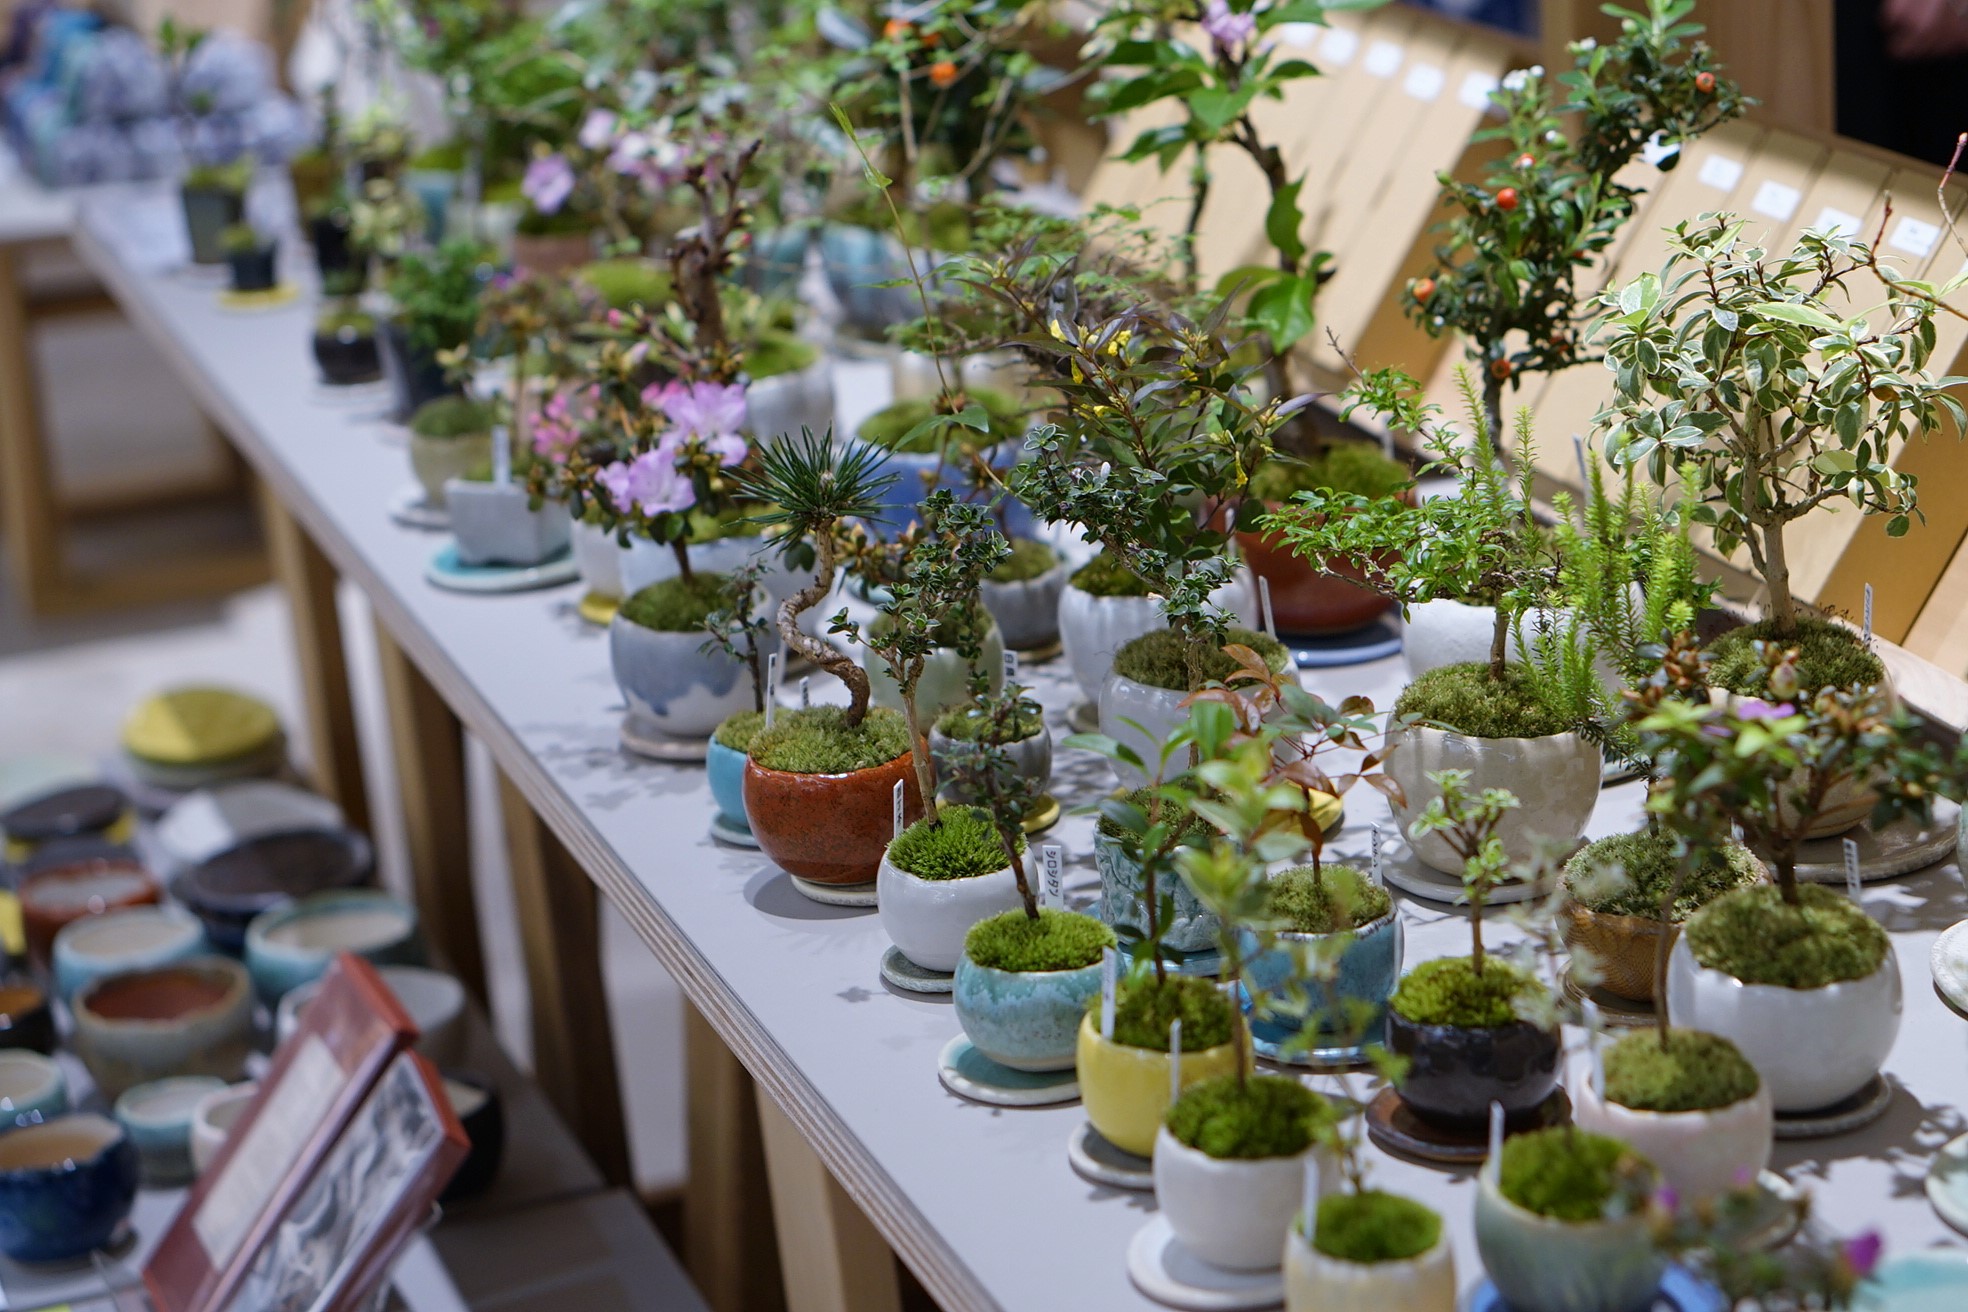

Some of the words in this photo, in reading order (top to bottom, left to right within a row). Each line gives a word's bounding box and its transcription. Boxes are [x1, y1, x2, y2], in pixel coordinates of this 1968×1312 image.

[1046, 850, 1059, 897] シロシタン
